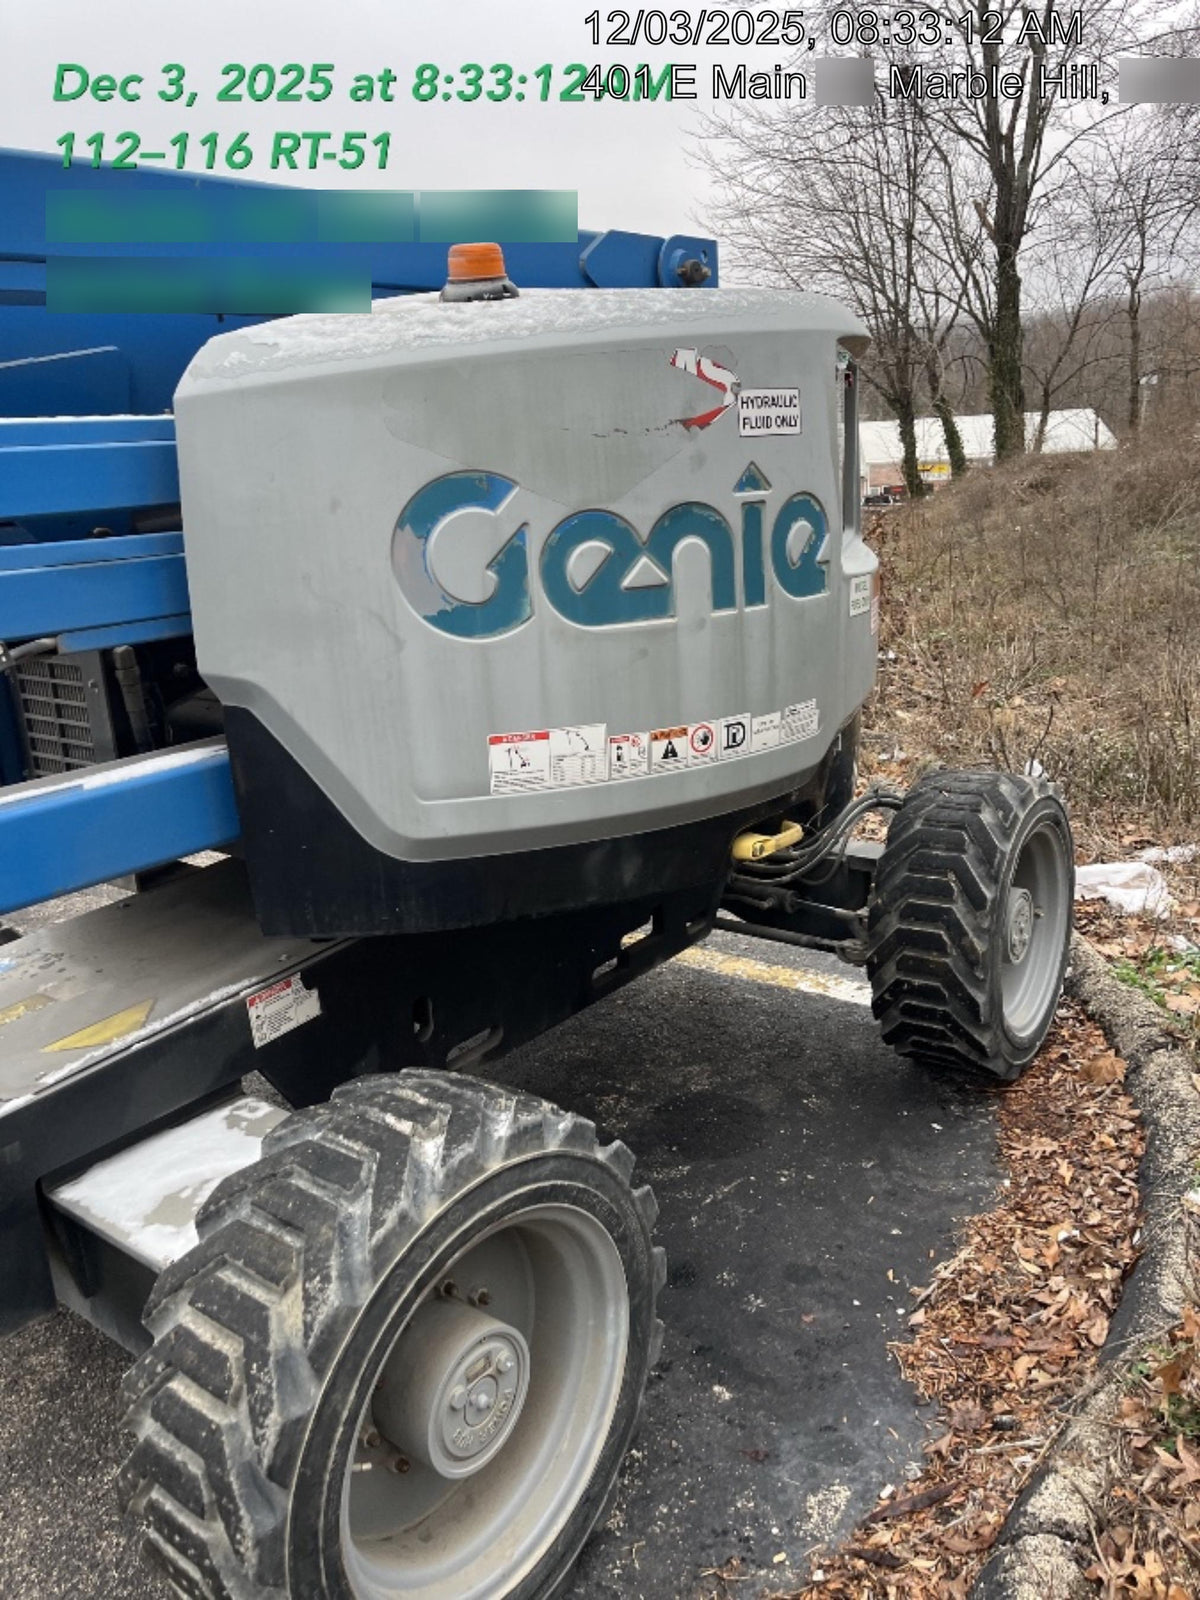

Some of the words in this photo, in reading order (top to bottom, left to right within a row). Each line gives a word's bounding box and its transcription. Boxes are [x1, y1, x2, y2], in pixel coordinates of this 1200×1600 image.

[740, 395, 797, 410] HYDRAULIC
[743, 415, 772, 430] FLUID
[775, 414, 799, 429] ONLY
[391, 462, 830, 643] Genie
